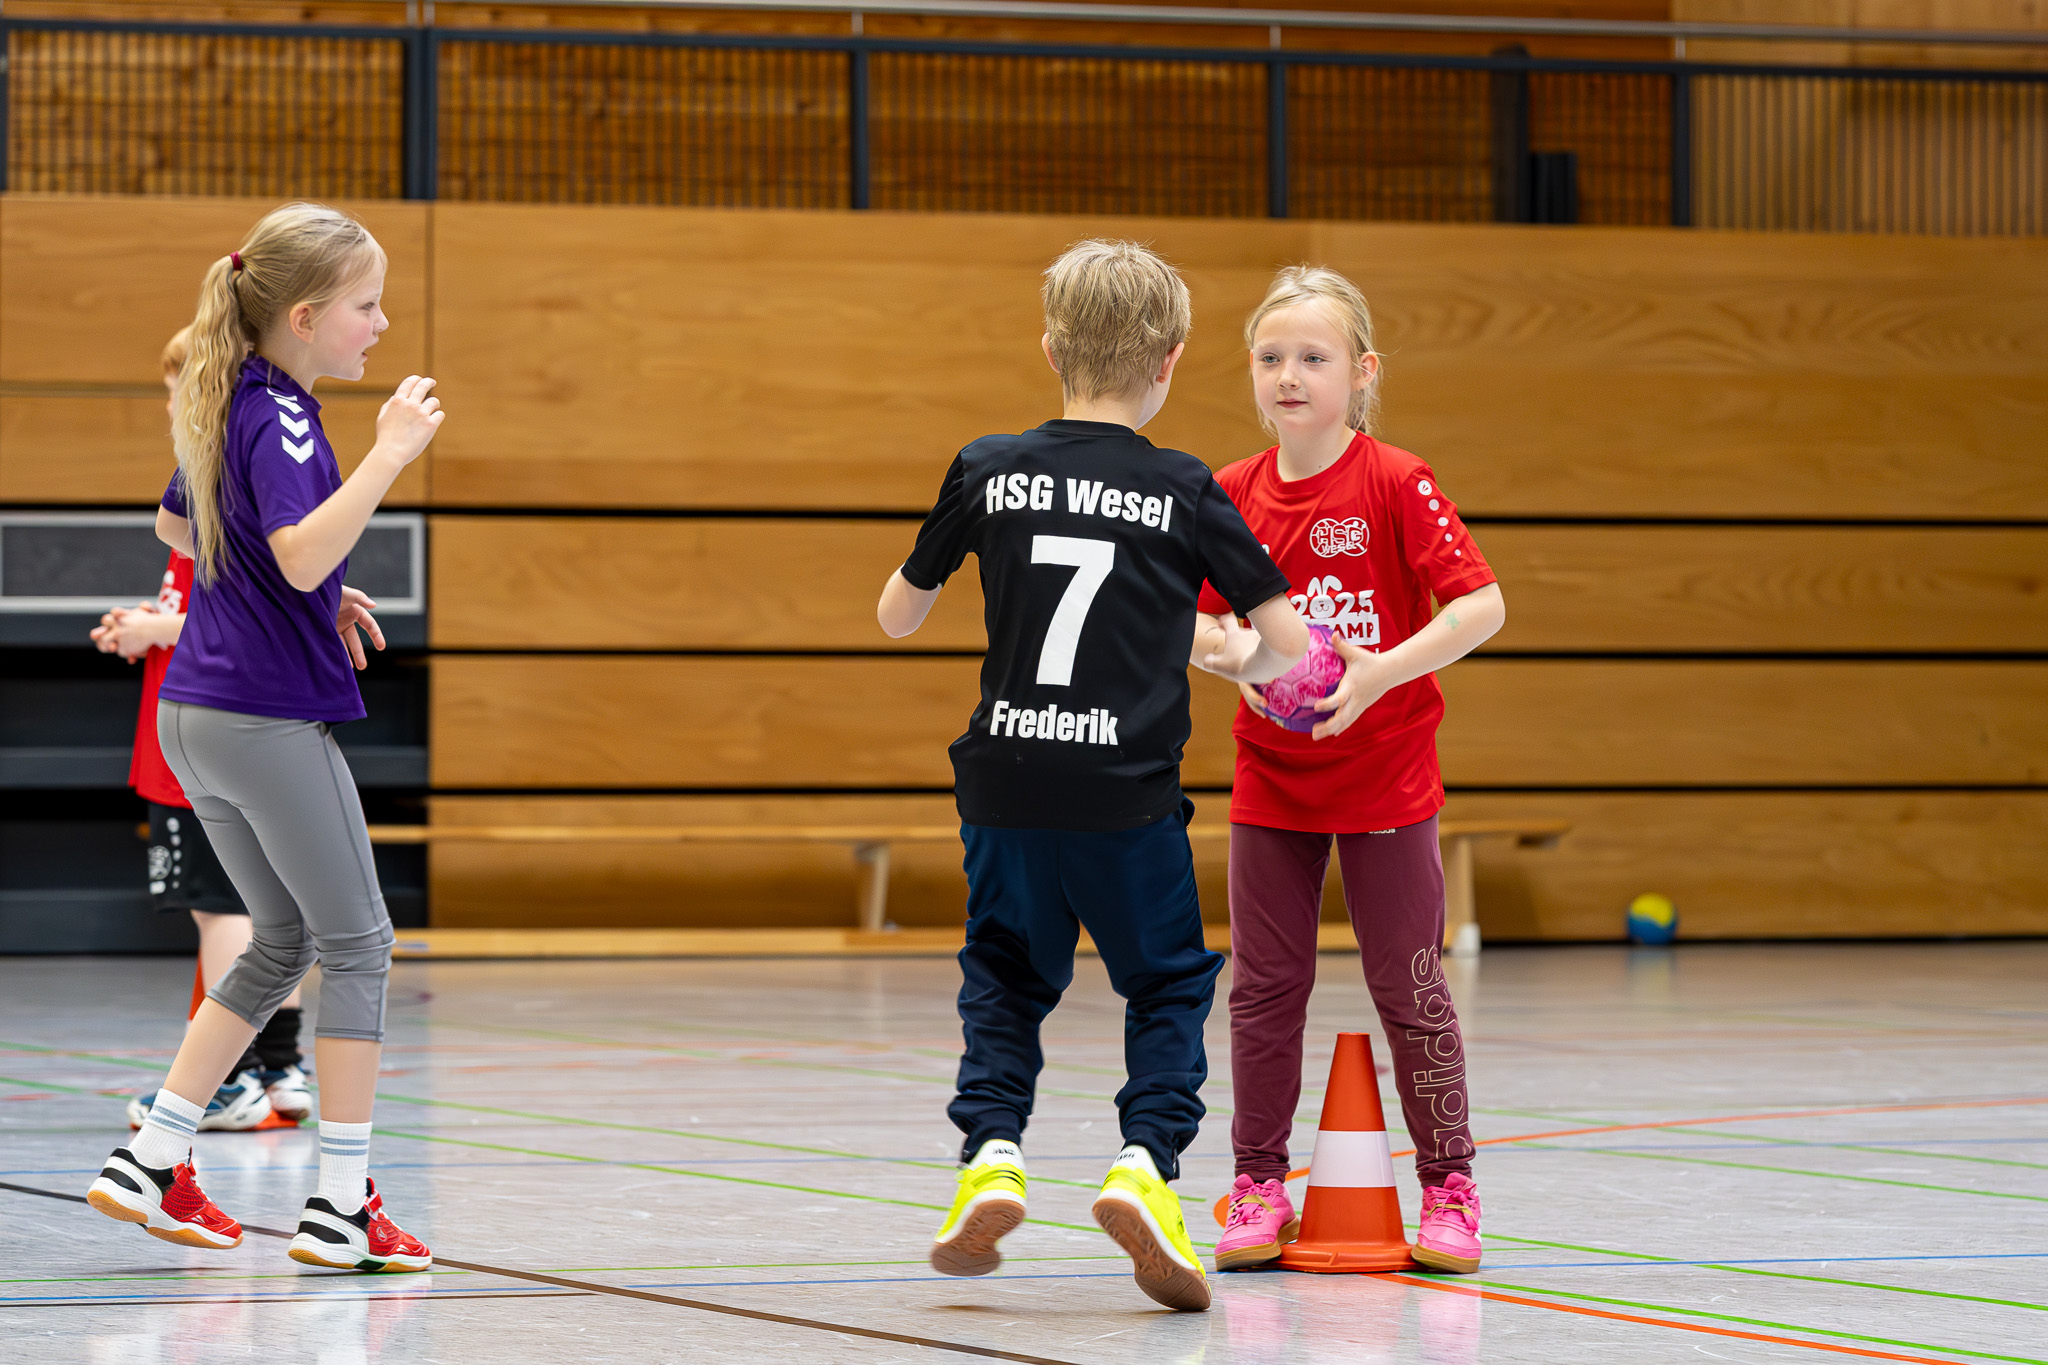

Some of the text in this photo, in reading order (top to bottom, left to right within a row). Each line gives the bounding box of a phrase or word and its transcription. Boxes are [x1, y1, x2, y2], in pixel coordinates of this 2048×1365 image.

[985, 472, 1174, 533] HSG Wesel
[1317, 524, 1364, 546] HSG
[1030, 534, 1116, 687] 7
[1323, 622, 1374, 640] AMP
[989, 700, 1119, 746] Frederik
[1406, 944, 1472, 1160] adidas
